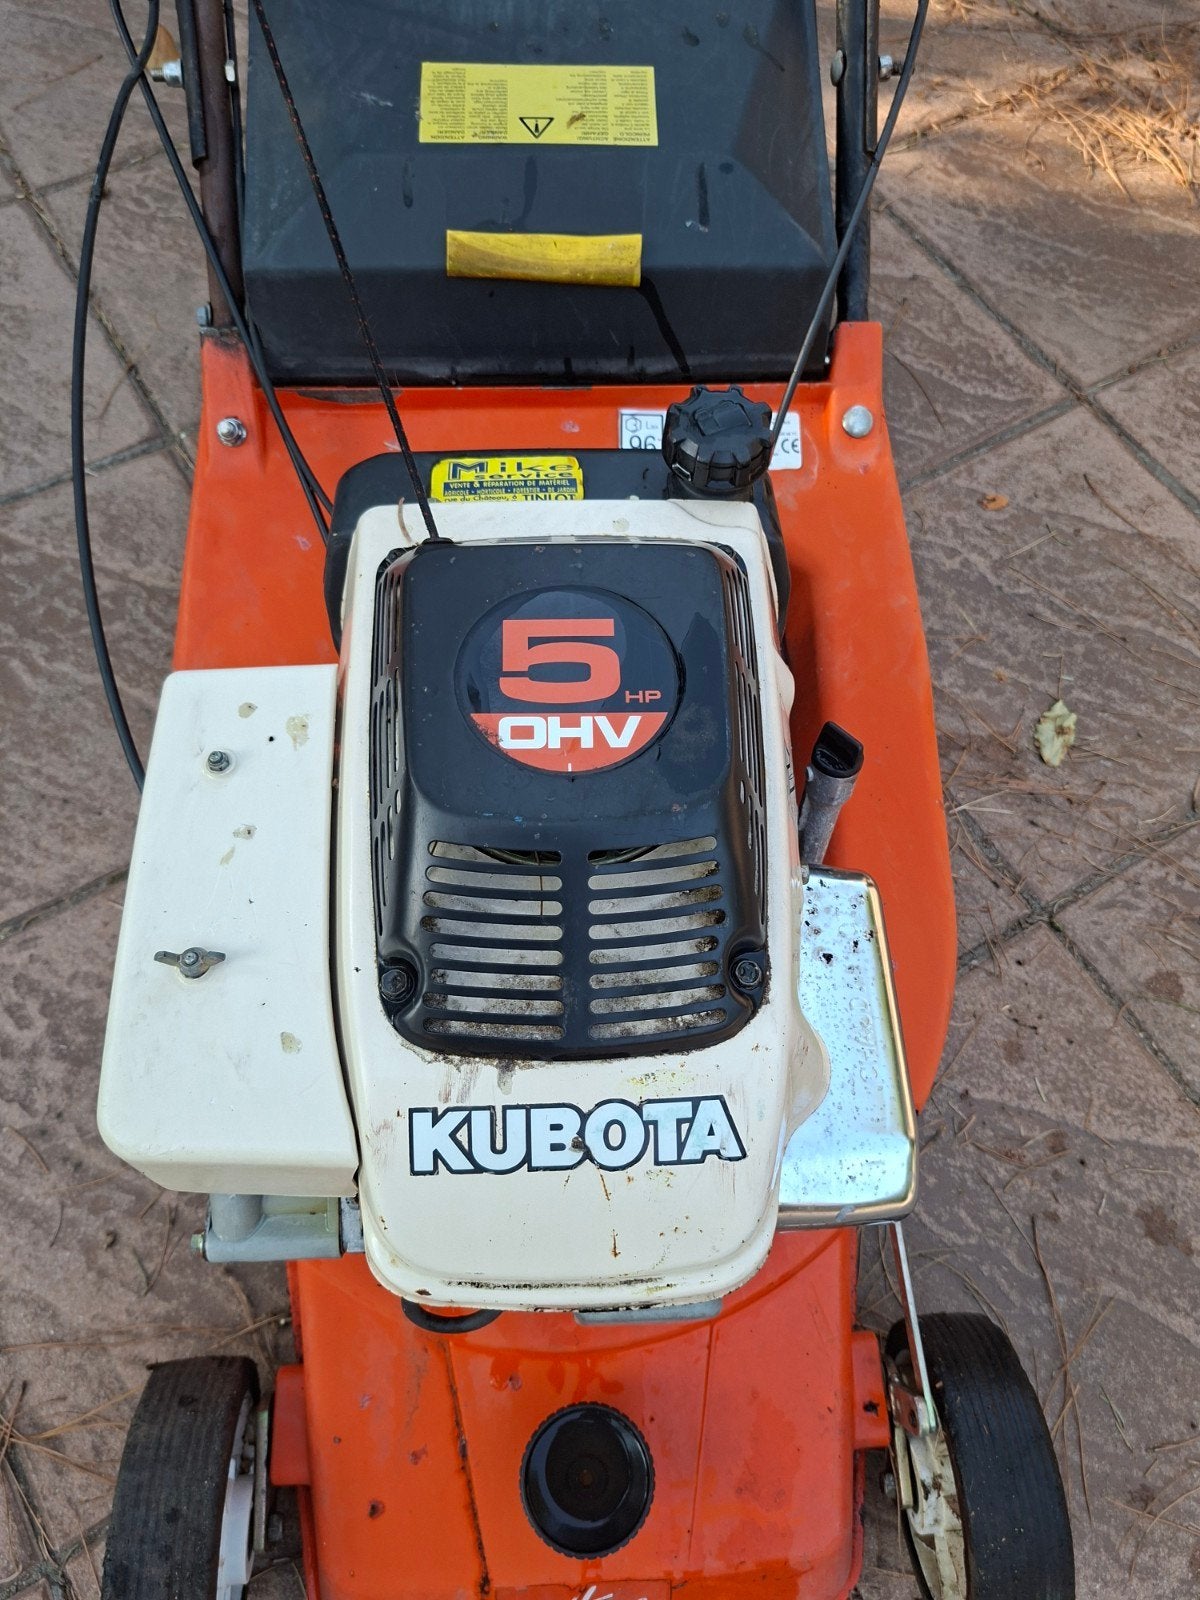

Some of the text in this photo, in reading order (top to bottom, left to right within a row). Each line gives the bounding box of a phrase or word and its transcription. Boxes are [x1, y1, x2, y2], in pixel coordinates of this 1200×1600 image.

[781, 439, 800, 454] CE
[448, 461, 574, 481] Mike
[474, 472, 574, 480] service
[483, 480, 525, 488] RÉPARATION
[499, 618, 662, 704] 5 HP
[499, 715, 642, 750] OHV
[408, 1095, 748, 1176] KUBOTA
